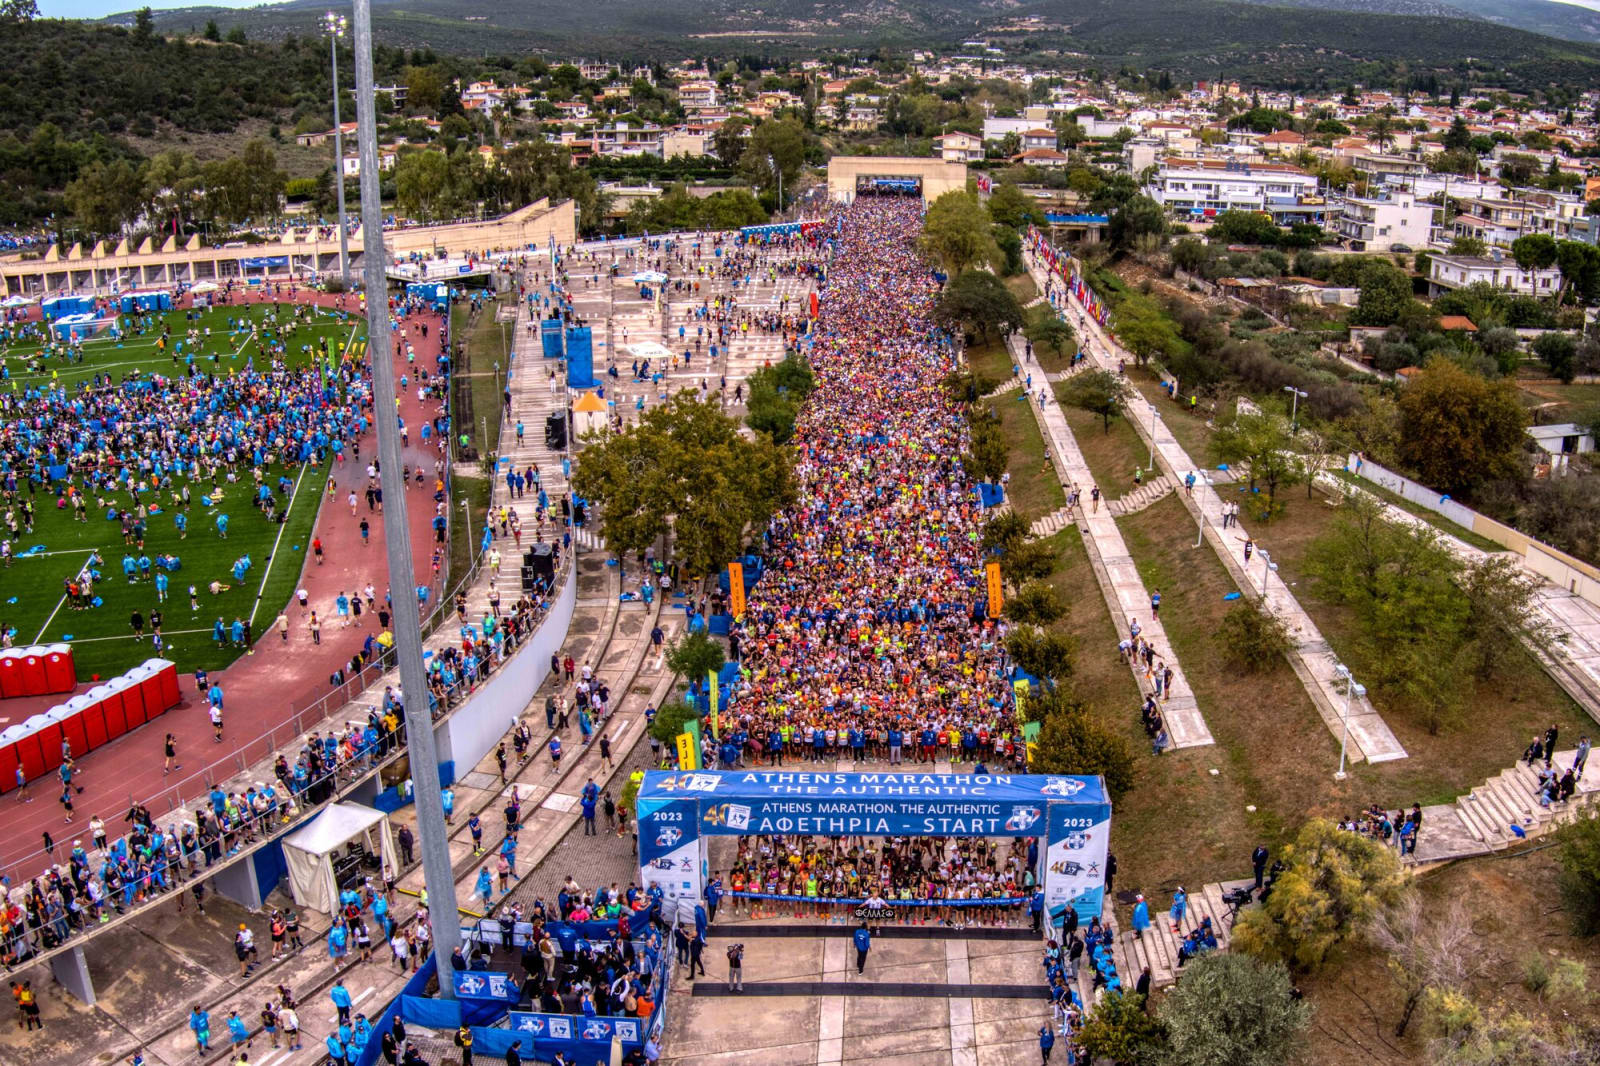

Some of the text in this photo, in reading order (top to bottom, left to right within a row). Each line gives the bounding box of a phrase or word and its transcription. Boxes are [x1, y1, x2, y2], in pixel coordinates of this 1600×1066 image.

[742, 773, 1011, 785] ATHENS MARATHON
[769, 785, 986, 794] THE AUTHENTIC
[762, 802, 812, 813] ATHENS
[819, 803, 897, 814] MARATHON.
[900, 803, 925, 814] THE
[927, 804, 1000, 815] AUTHENTIC
[653, 811, 683, 821] 2023
[759, 816, 890, 833] ΑΦΕΤΗΡΙΑ
[923, 817, 1000, 833] START
[1063, 818, 1093, 828] 2023
